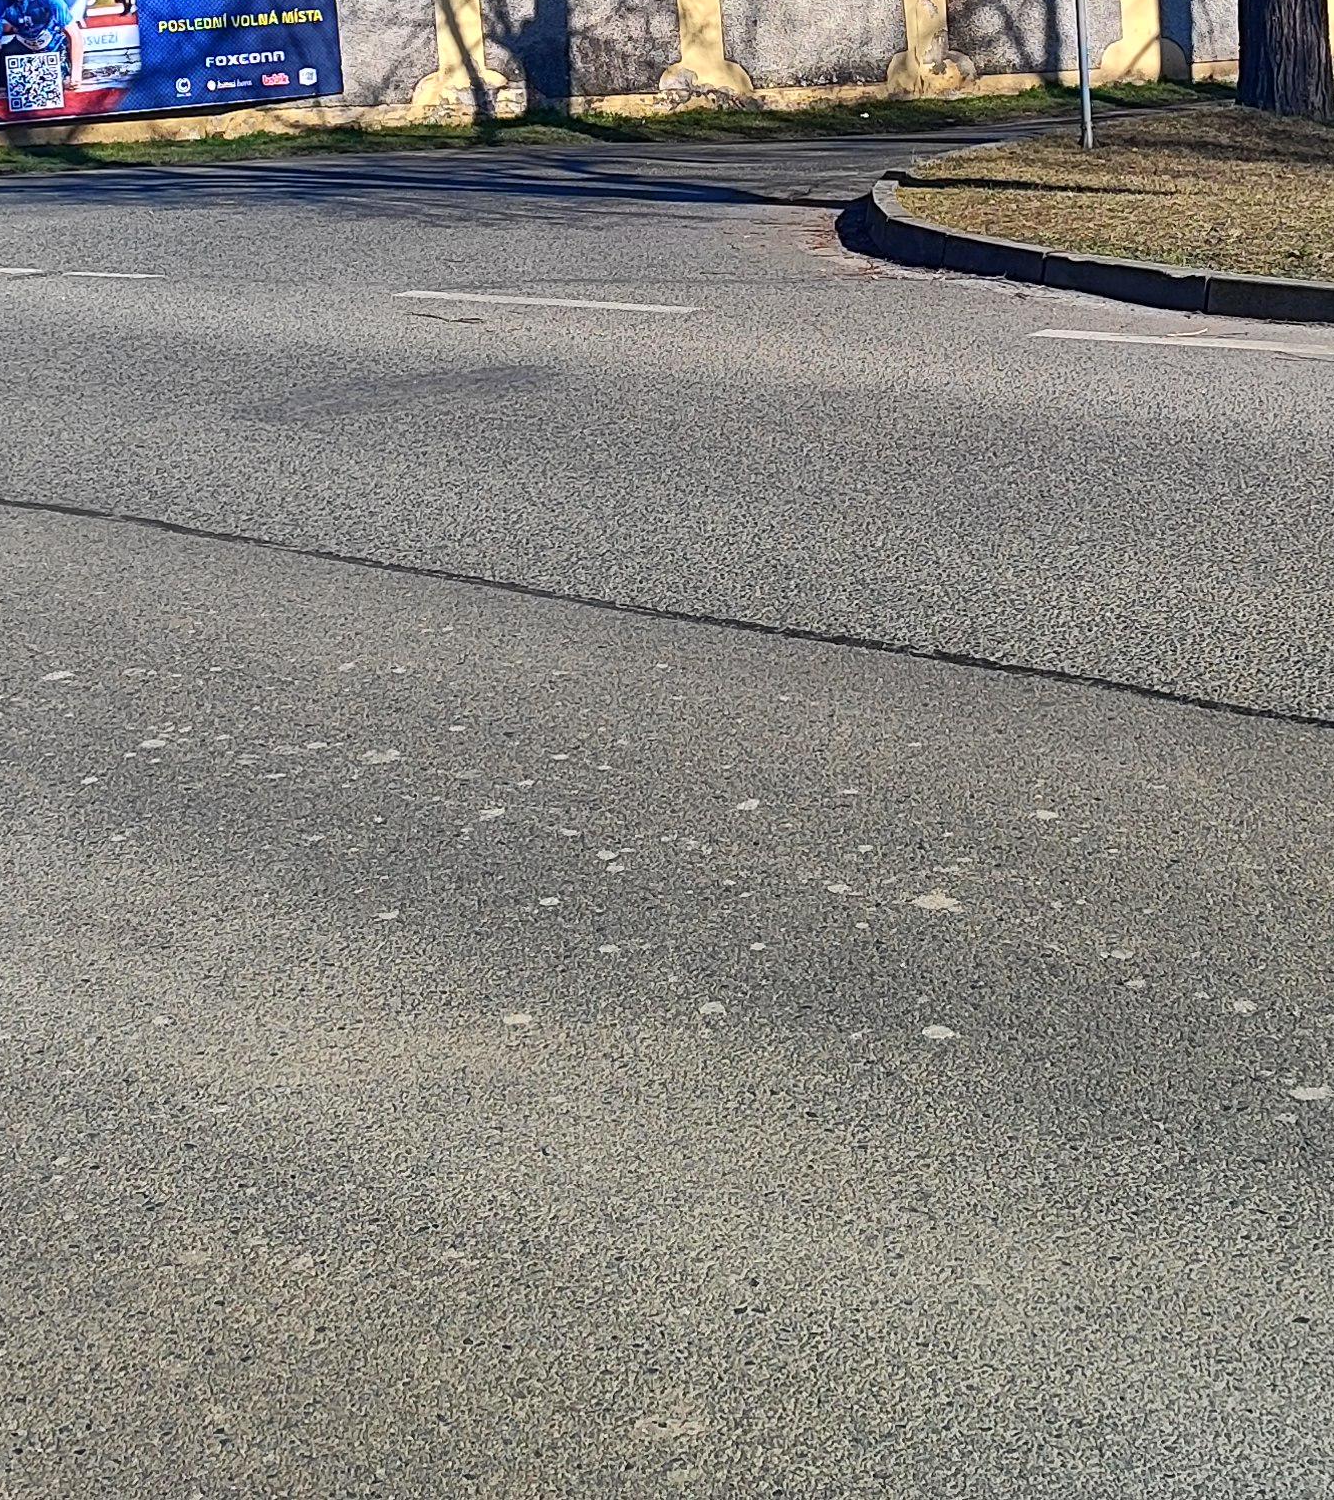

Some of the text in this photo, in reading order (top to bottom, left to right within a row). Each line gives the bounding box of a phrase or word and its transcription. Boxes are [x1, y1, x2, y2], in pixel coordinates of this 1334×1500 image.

[158, 7, 324, 34] POSLEDNÍ VOLNÁ MÍSTA
